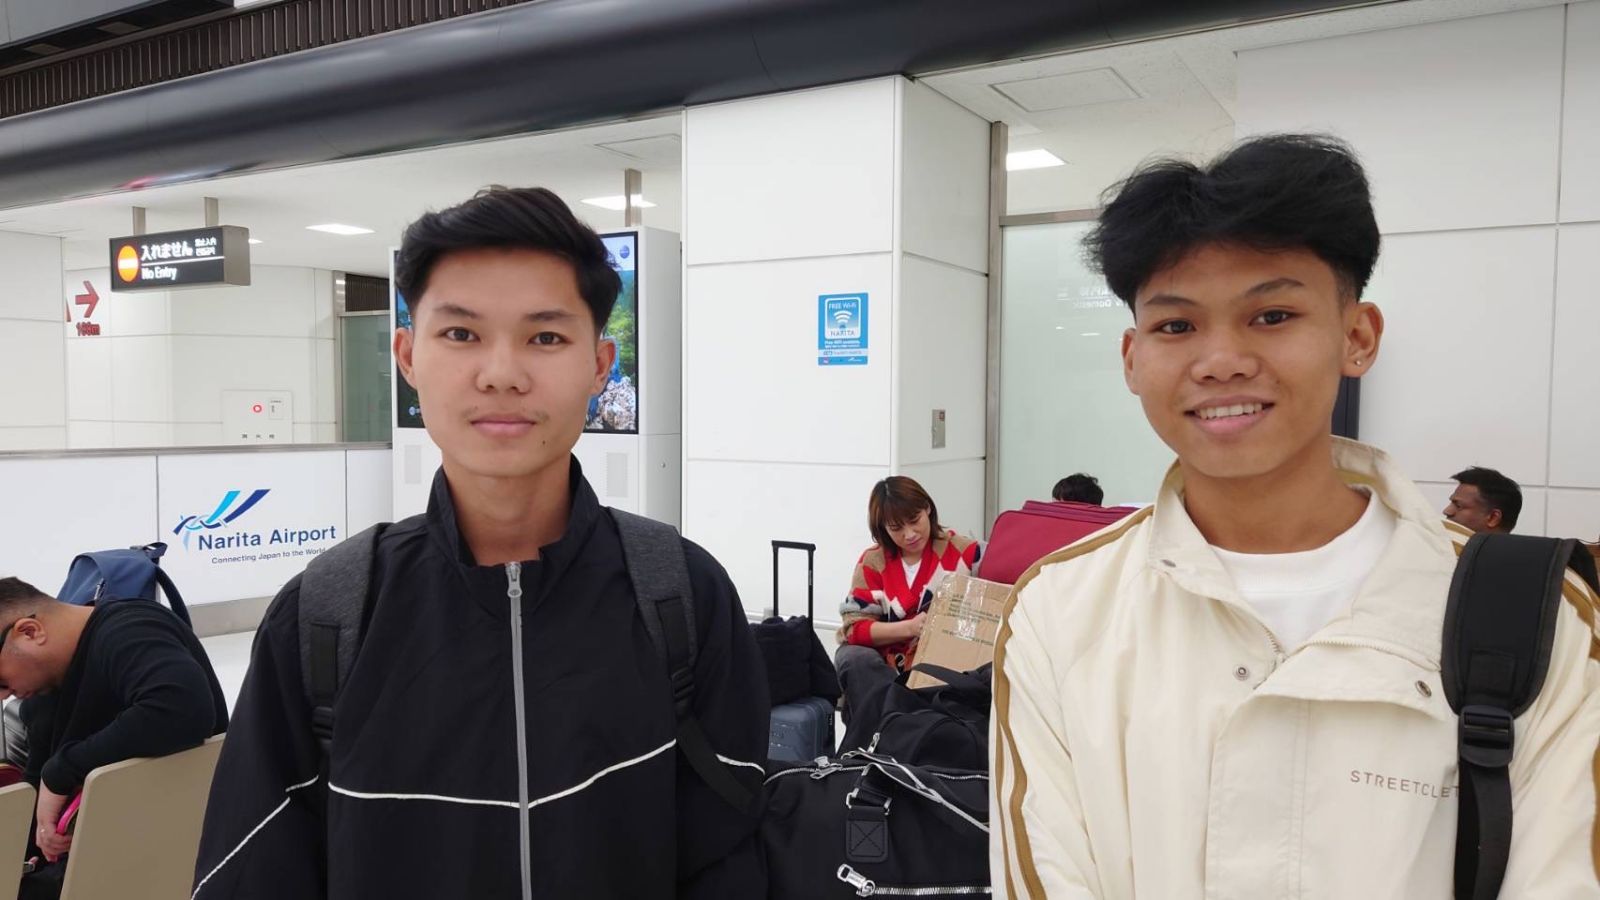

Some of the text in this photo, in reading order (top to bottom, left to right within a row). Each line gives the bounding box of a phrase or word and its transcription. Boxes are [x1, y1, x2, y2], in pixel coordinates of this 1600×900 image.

[142, 267, 177, 280] No Entry
[198, 525, 336, 550] Narita Airport
[211, 546, 327, 565] Connecting Japan to the World
